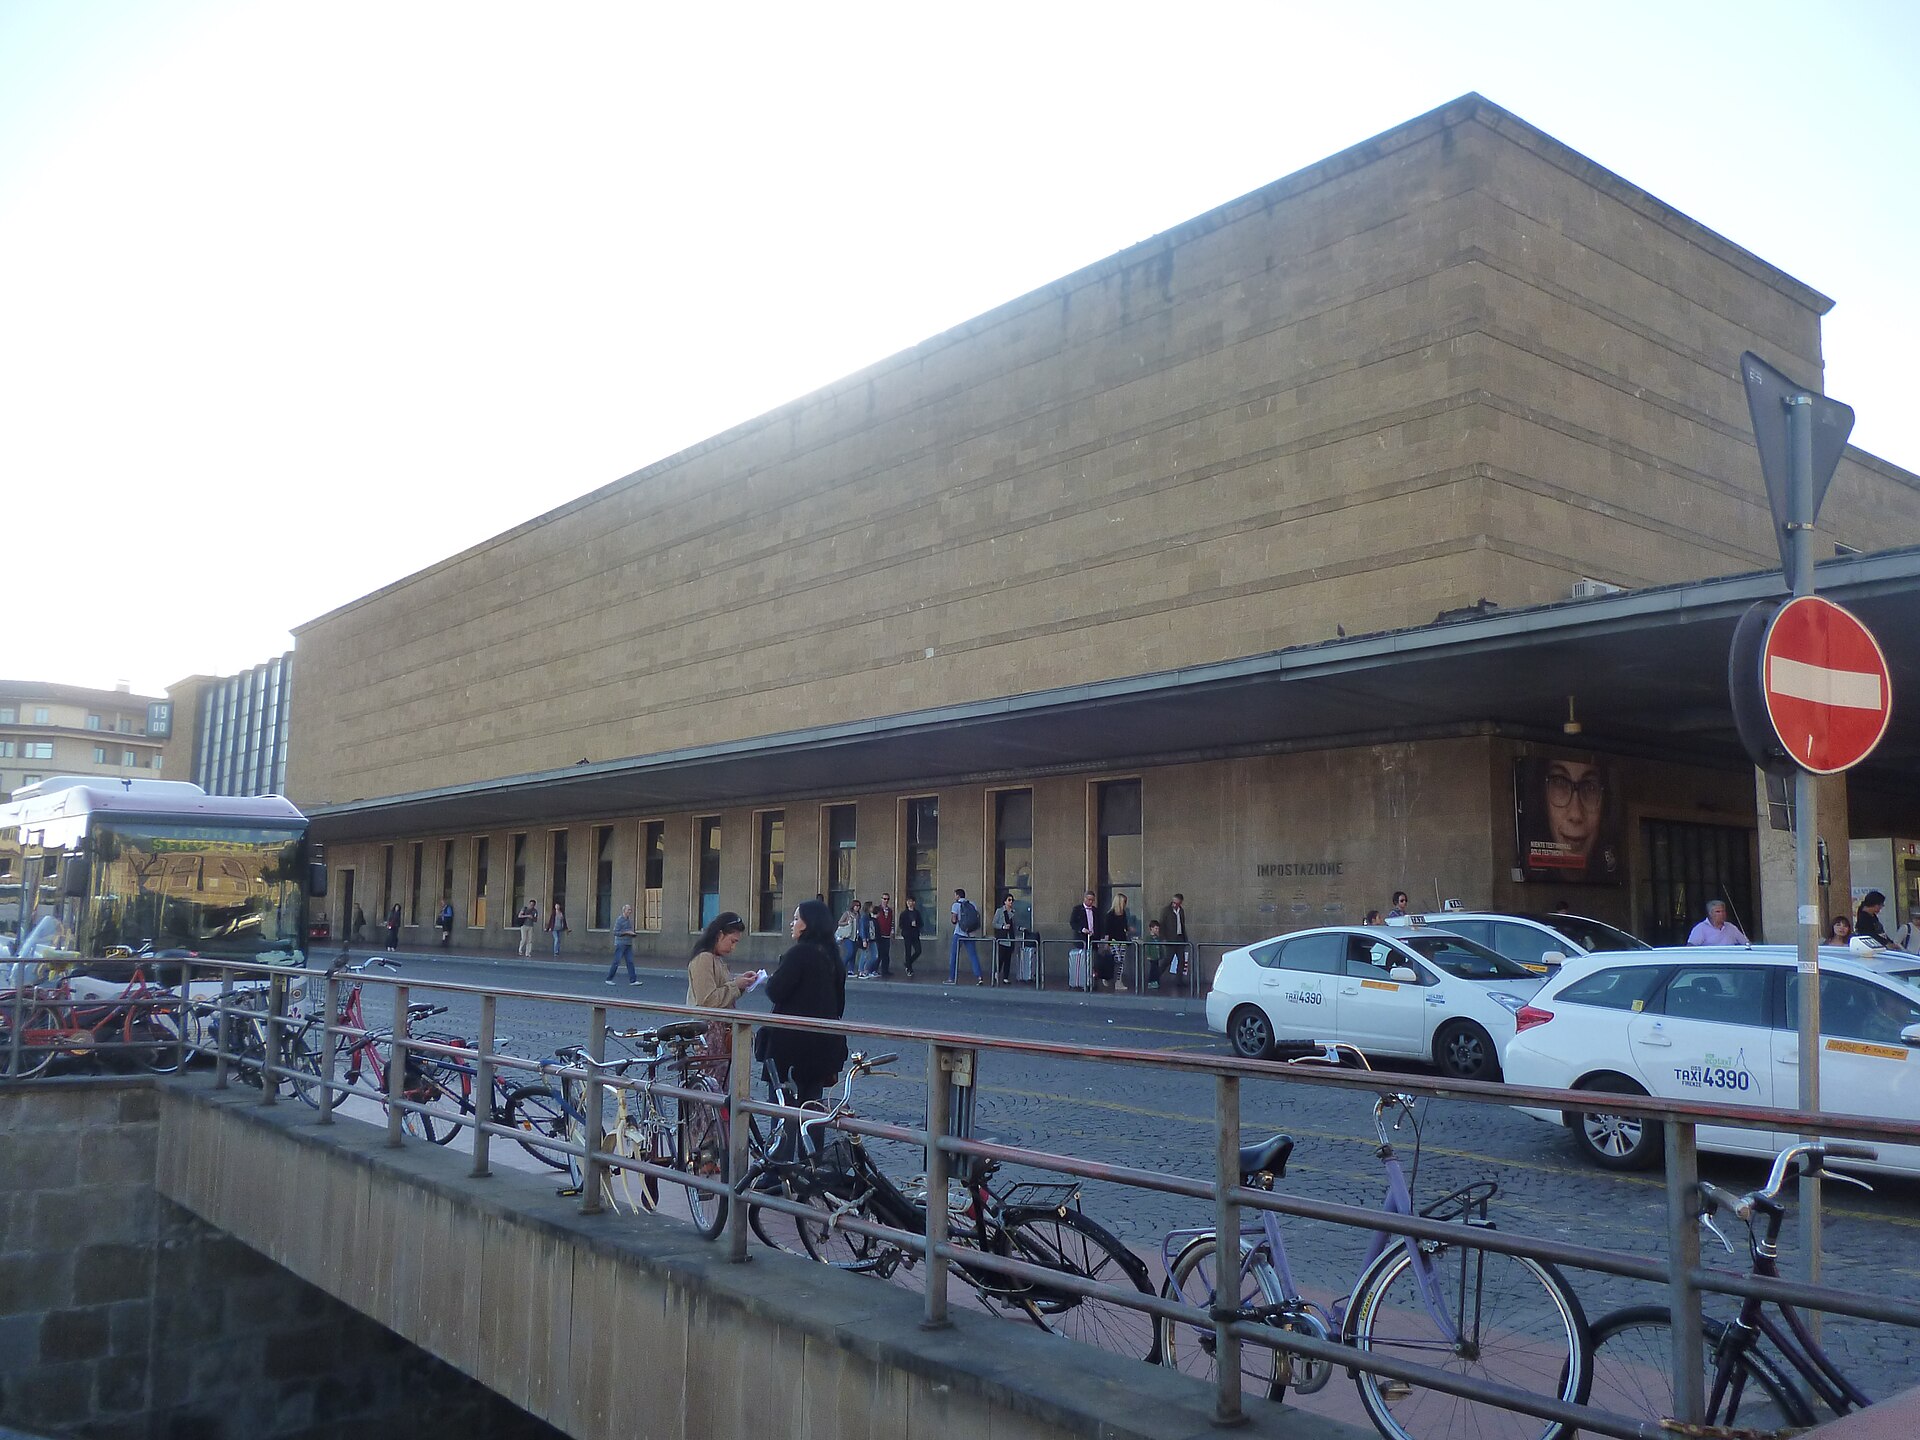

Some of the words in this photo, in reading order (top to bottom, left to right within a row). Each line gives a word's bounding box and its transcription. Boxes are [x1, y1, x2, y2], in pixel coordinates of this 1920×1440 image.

[154, 705, 168, 719] 19
[1257, 863, 1343, 877] IMPOSTAZIONE
[1285, 992, 1300, 1001] TAXI
[1298, 991, 1322, 1005] 4390
[1674, 1068, 1702, 1082] TAXI
[1703, 1067, 1749, 1091] 4390
[1682, 1080, 1702, 1088] FIRENZE
